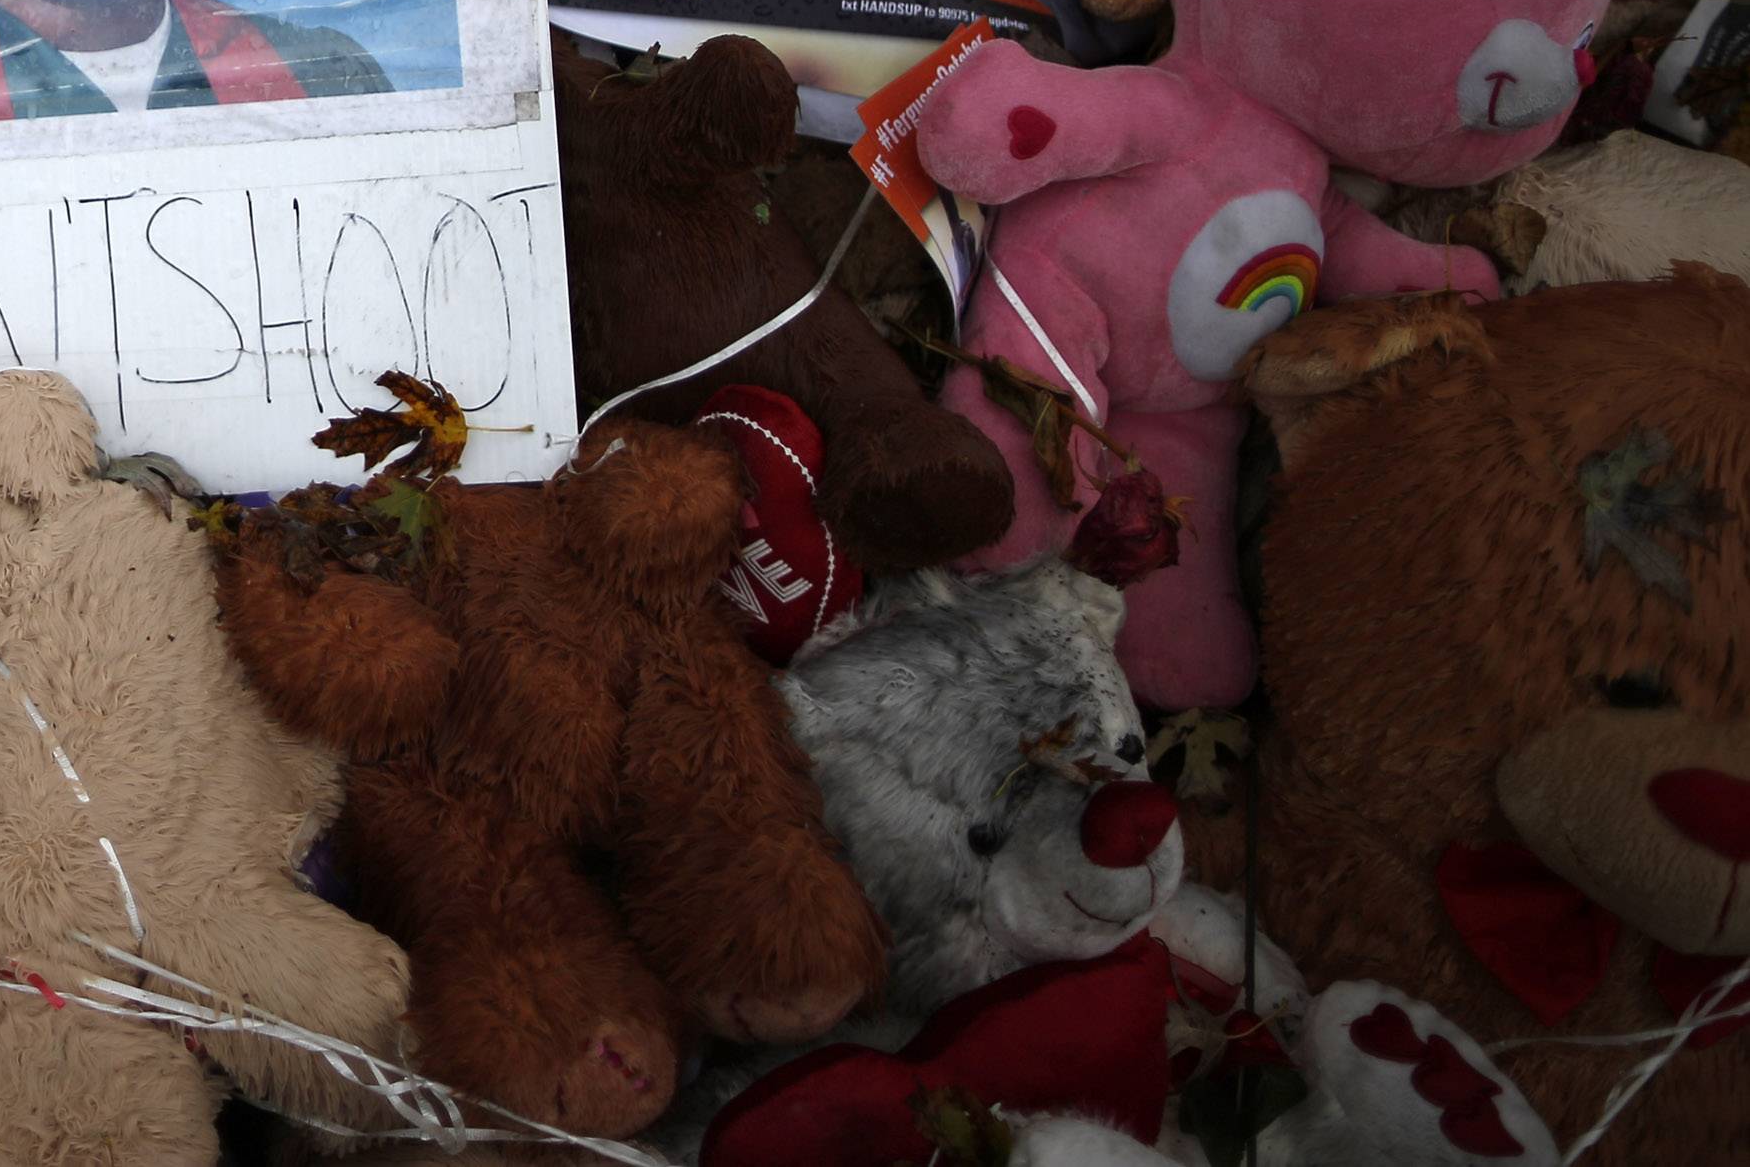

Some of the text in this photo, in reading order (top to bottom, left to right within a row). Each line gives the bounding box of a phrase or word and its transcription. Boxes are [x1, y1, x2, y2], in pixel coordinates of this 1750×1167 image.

[841, 0, 857, 11] txt
[860, 0, 922, 17] HANDSUP
[924, 5, 936, 17] to
